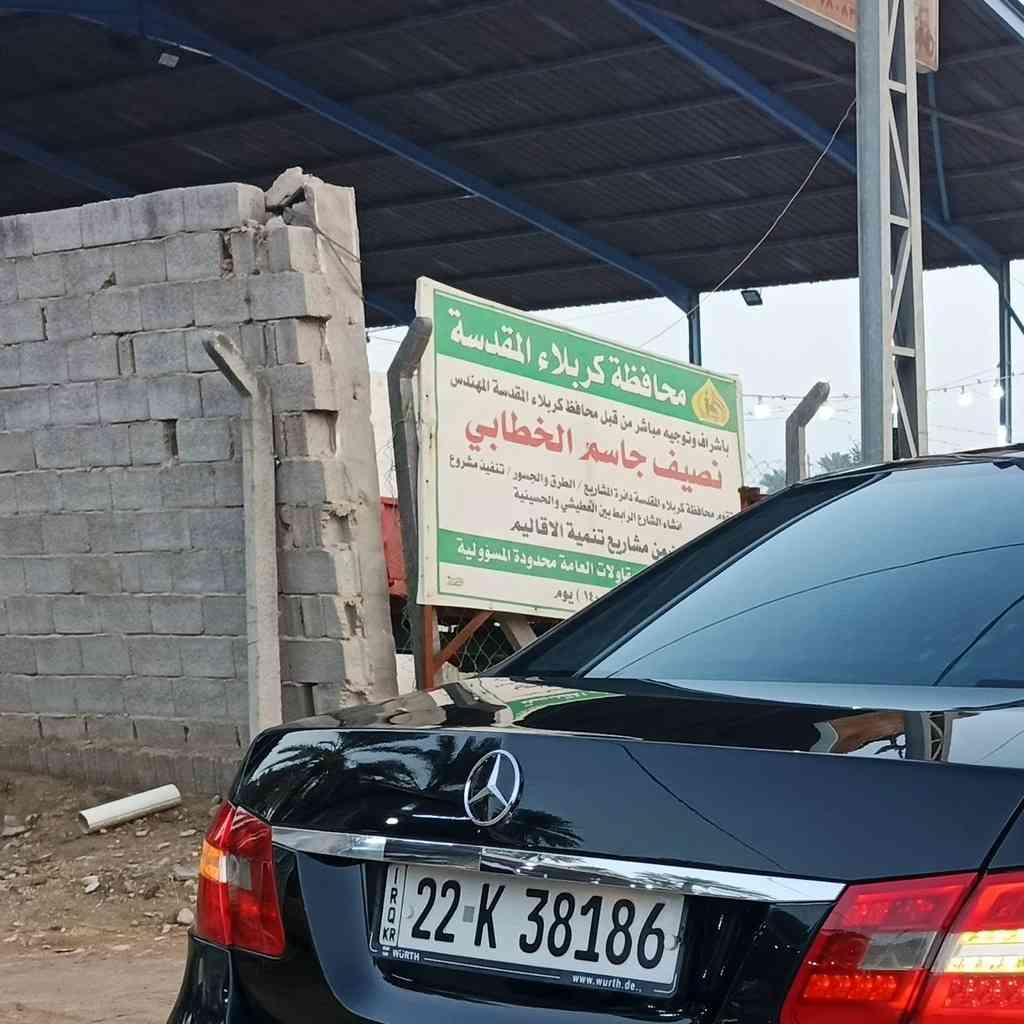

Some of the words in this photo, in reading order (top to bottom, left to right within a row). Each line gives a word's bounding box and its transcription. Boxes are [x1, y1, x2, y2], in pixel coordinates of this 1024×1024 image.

[448, 308, 531, 364] المقدسة
[538, 342, 605, 389] كربلاء
[449, 374, 491, 394] المهندس
[492, 378, 530, 403] المقدسة
[608, 355, 688, 407] محافظة
[532, 393, 564, 414] كربلاء
[565, 400, 598, 419] محافظ
[600, 409, 619, 428] قبل
[620, 414, 633, 431] من
[634, 417, 662, 439] مباشر
[465, 409, 574, 454] الخطابي
[663, 427, 698, 450] وتوجيه
[698, 432, 730, 458] باشراف
[448, 454, 479, 470] مشروع
[480, 459, 505, 476] تنفيذ
[578, 439, 647, 478] جاسم
[512, 471, 549, 487] والجسور
[550, 474, 576, 490] الطرق
[652, 449, 722, 494] نصيف
[567, 521, 605, 547] تنمية
[607, 534, 649, 555] مشاريع
[513, 548, 558, 570] محدودة
[560, 554, 595, 576] العامة
[554, 589, 573, 605] يوم
[382, 927, 396, 942] KR
[411, 877, 461, 943] 22
[474, 883, 506, 949] K
[519, 888, 666, 970] 38186
